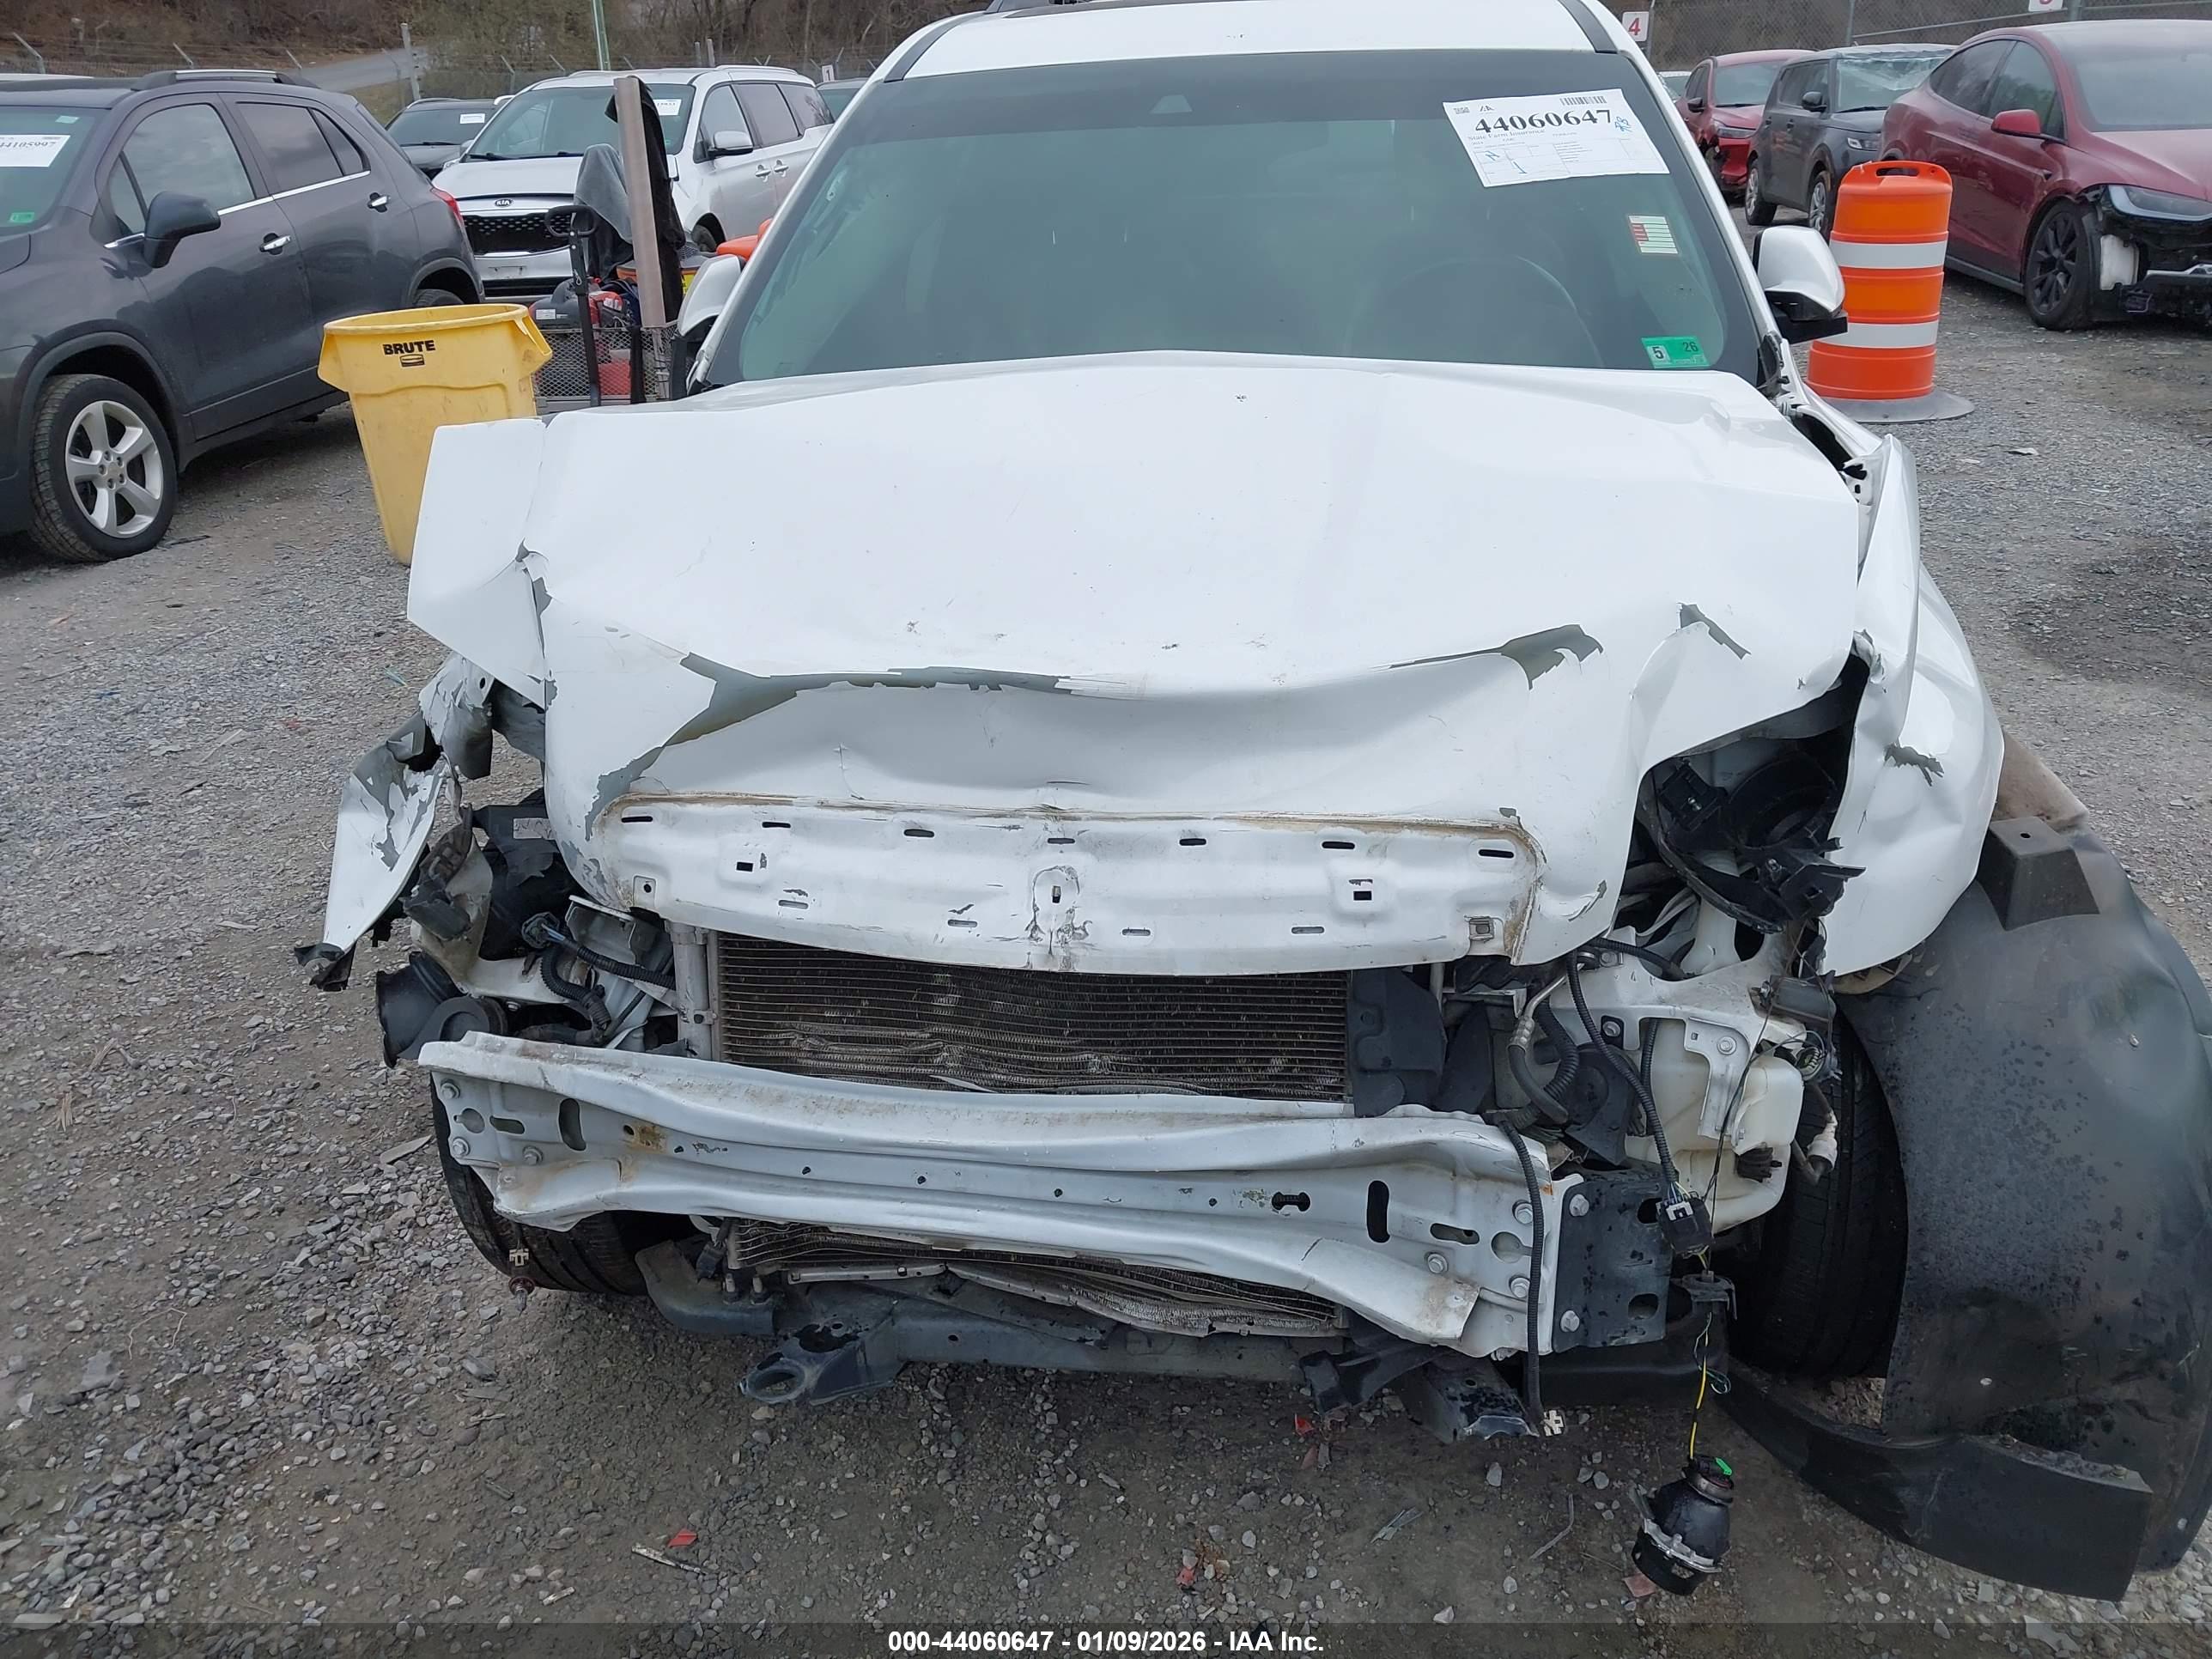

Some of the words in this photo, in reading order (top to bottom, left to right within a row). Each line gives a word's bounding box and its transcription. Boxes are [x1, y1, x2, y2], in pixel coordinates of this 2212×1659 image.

[1628, 17, 1640, 35] 4
[1475, 109, 1611, 133] 44060647
[382, 340, 436, 356] BRUTE
[1652, 346, 1664, 360] 5
[1682, 342, 1698, 352] 26
